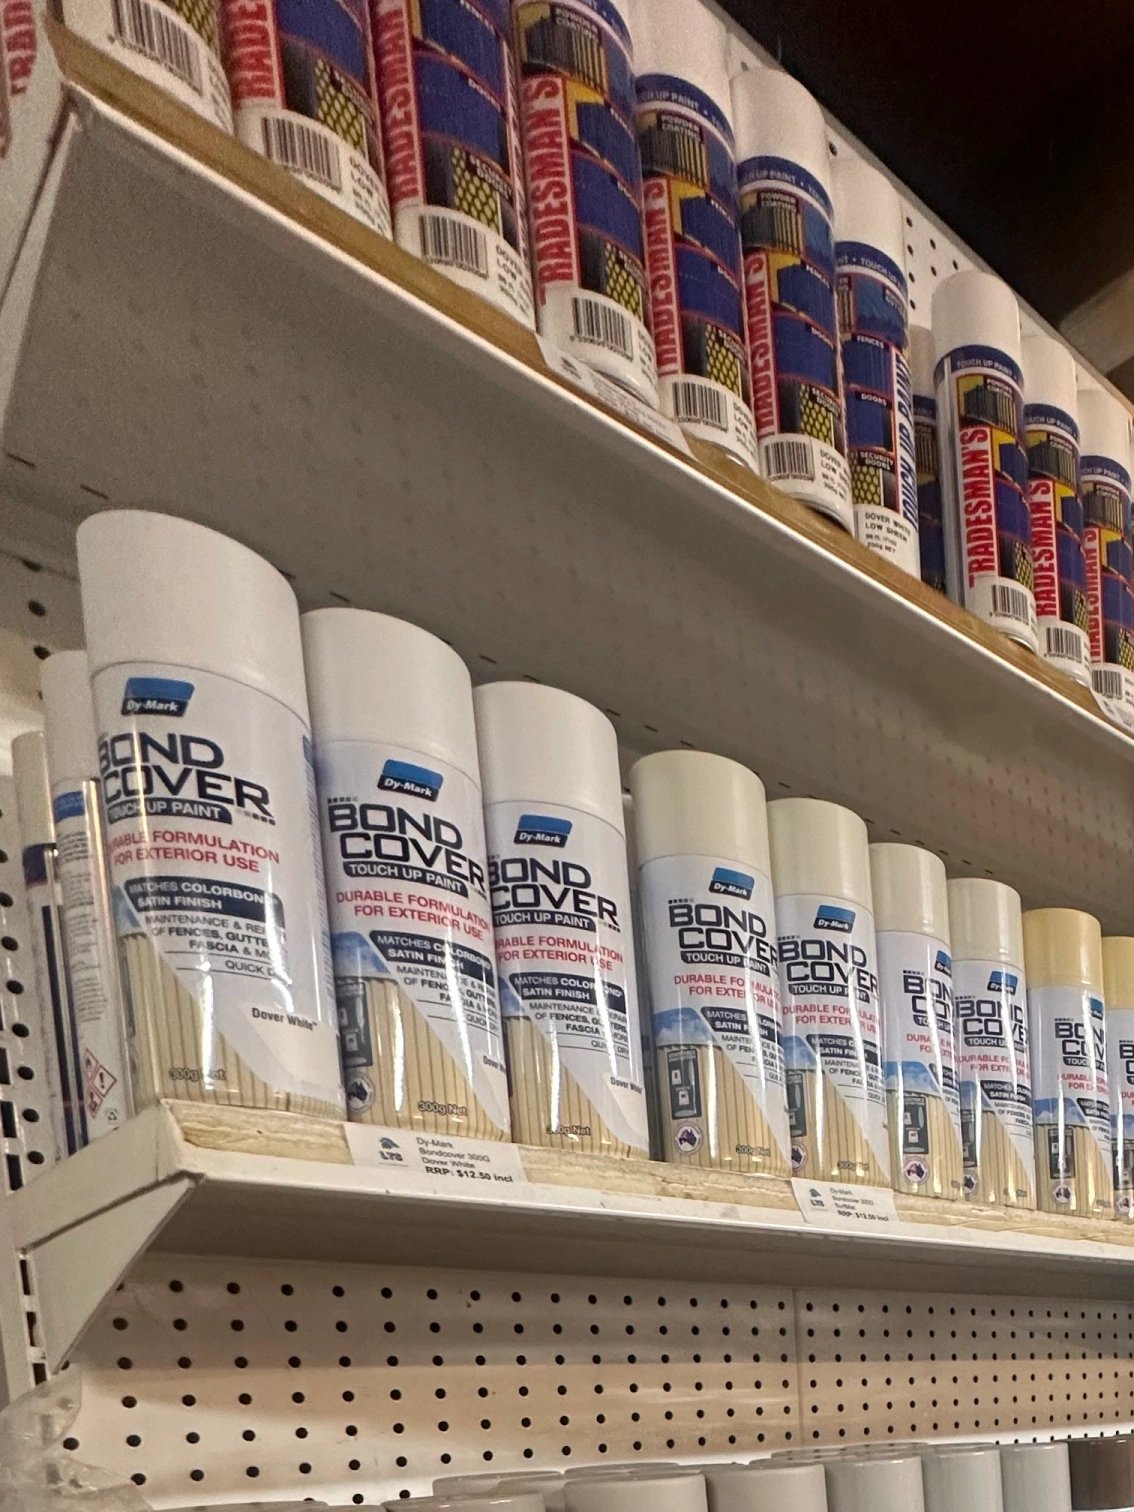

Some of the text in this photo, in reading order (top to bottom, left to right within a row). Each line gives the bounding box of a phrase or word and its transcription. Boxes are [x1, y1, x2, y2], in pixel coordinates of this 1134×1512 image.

[857, 335, 885, 349] FENCES
[861, 393, 887, 406] DOORS
[960, 426, 996, 589] TRADESMAN'S
[126, 701, 178, 712] Dy-Mark
[384, 778, 432, 797] Dy-Mark
[328, 803, 463, 850] BOND
[519, 833, 561, 843] Dy-Mark
[153, 830, 280, 864] FORMULATION
[223, 855, 260, 873] USE
[340, 832, 488, 895] COVER
[349, 863, 462, 892] TOUCH UP PAINT
[174, 897, 223, 910] FINISH
[336, 891, 403, 904] DURABLE
[354, 905, 384, 917] FOR
[491, 884, 619, 927] COVER
[495, 912, 590, 929] TOUCH UP PAINT
[669, 904, 767, 938] BOND
[377, 935, 431, 950] MATCHES
[387, 950, 424, 961] SATIN
[523, 949, 587, 963] EXTERIOR
[686, 953, 724, 963] TOUCH
[778, 940, 867, 968] BOND
[674, 975, 727, 985] DURABLE
[522, 988, 590, 1000] SATIN FINISH
[783, 1004, 829, 1015] DURABLE
[416, 1137, 453, 1149] Dy-Mark
[457, 1170, 513, 1183] $12.50 incl
